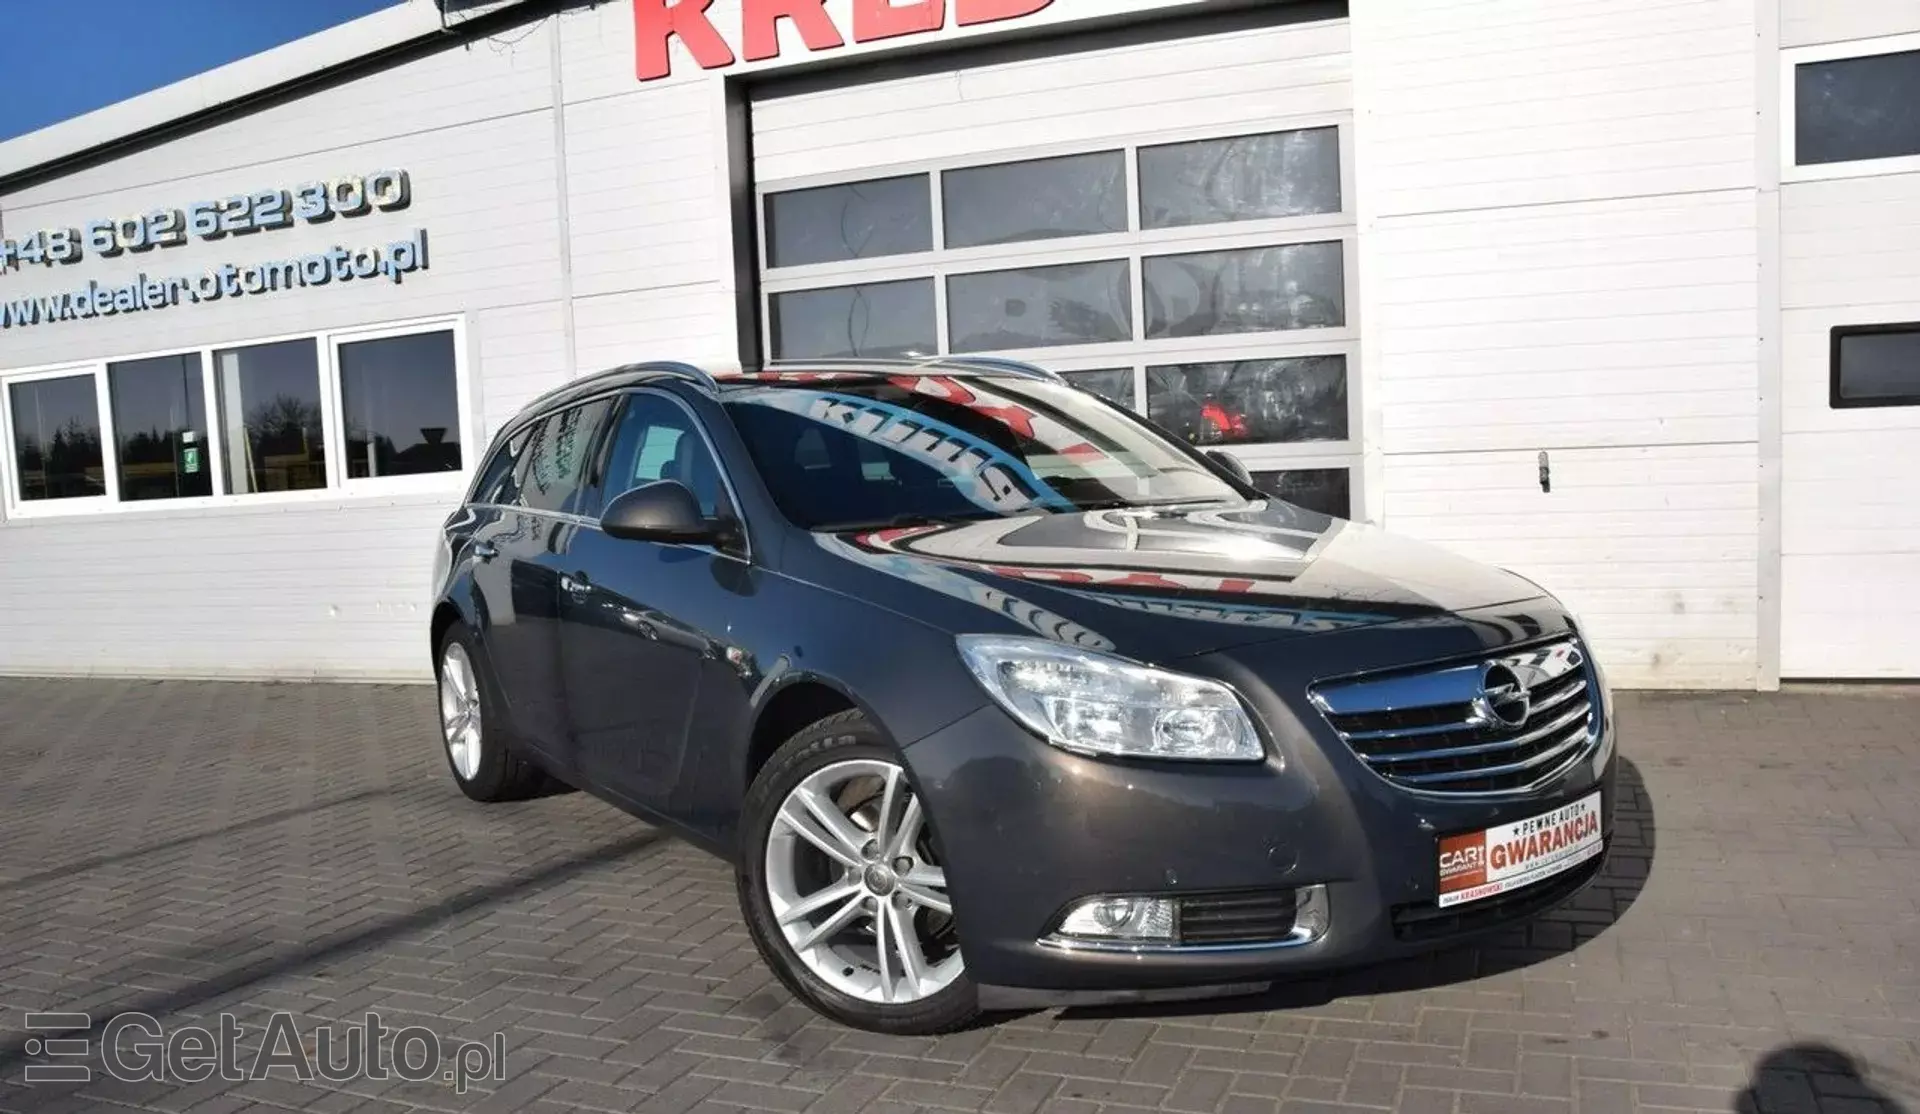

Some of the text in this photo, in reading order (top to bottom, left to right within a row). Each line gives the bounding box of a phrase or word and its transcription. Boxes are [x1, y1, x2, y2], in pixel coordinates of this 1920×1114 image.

[85, 207, 187, 257] 602
[188, 189, 293, 241] 622
[294, 168, 411, 224] 300
[1490, 810, 1598, 870] GWARANCJA
[1522, 803, 1581, 836] PEWNE AUTO
